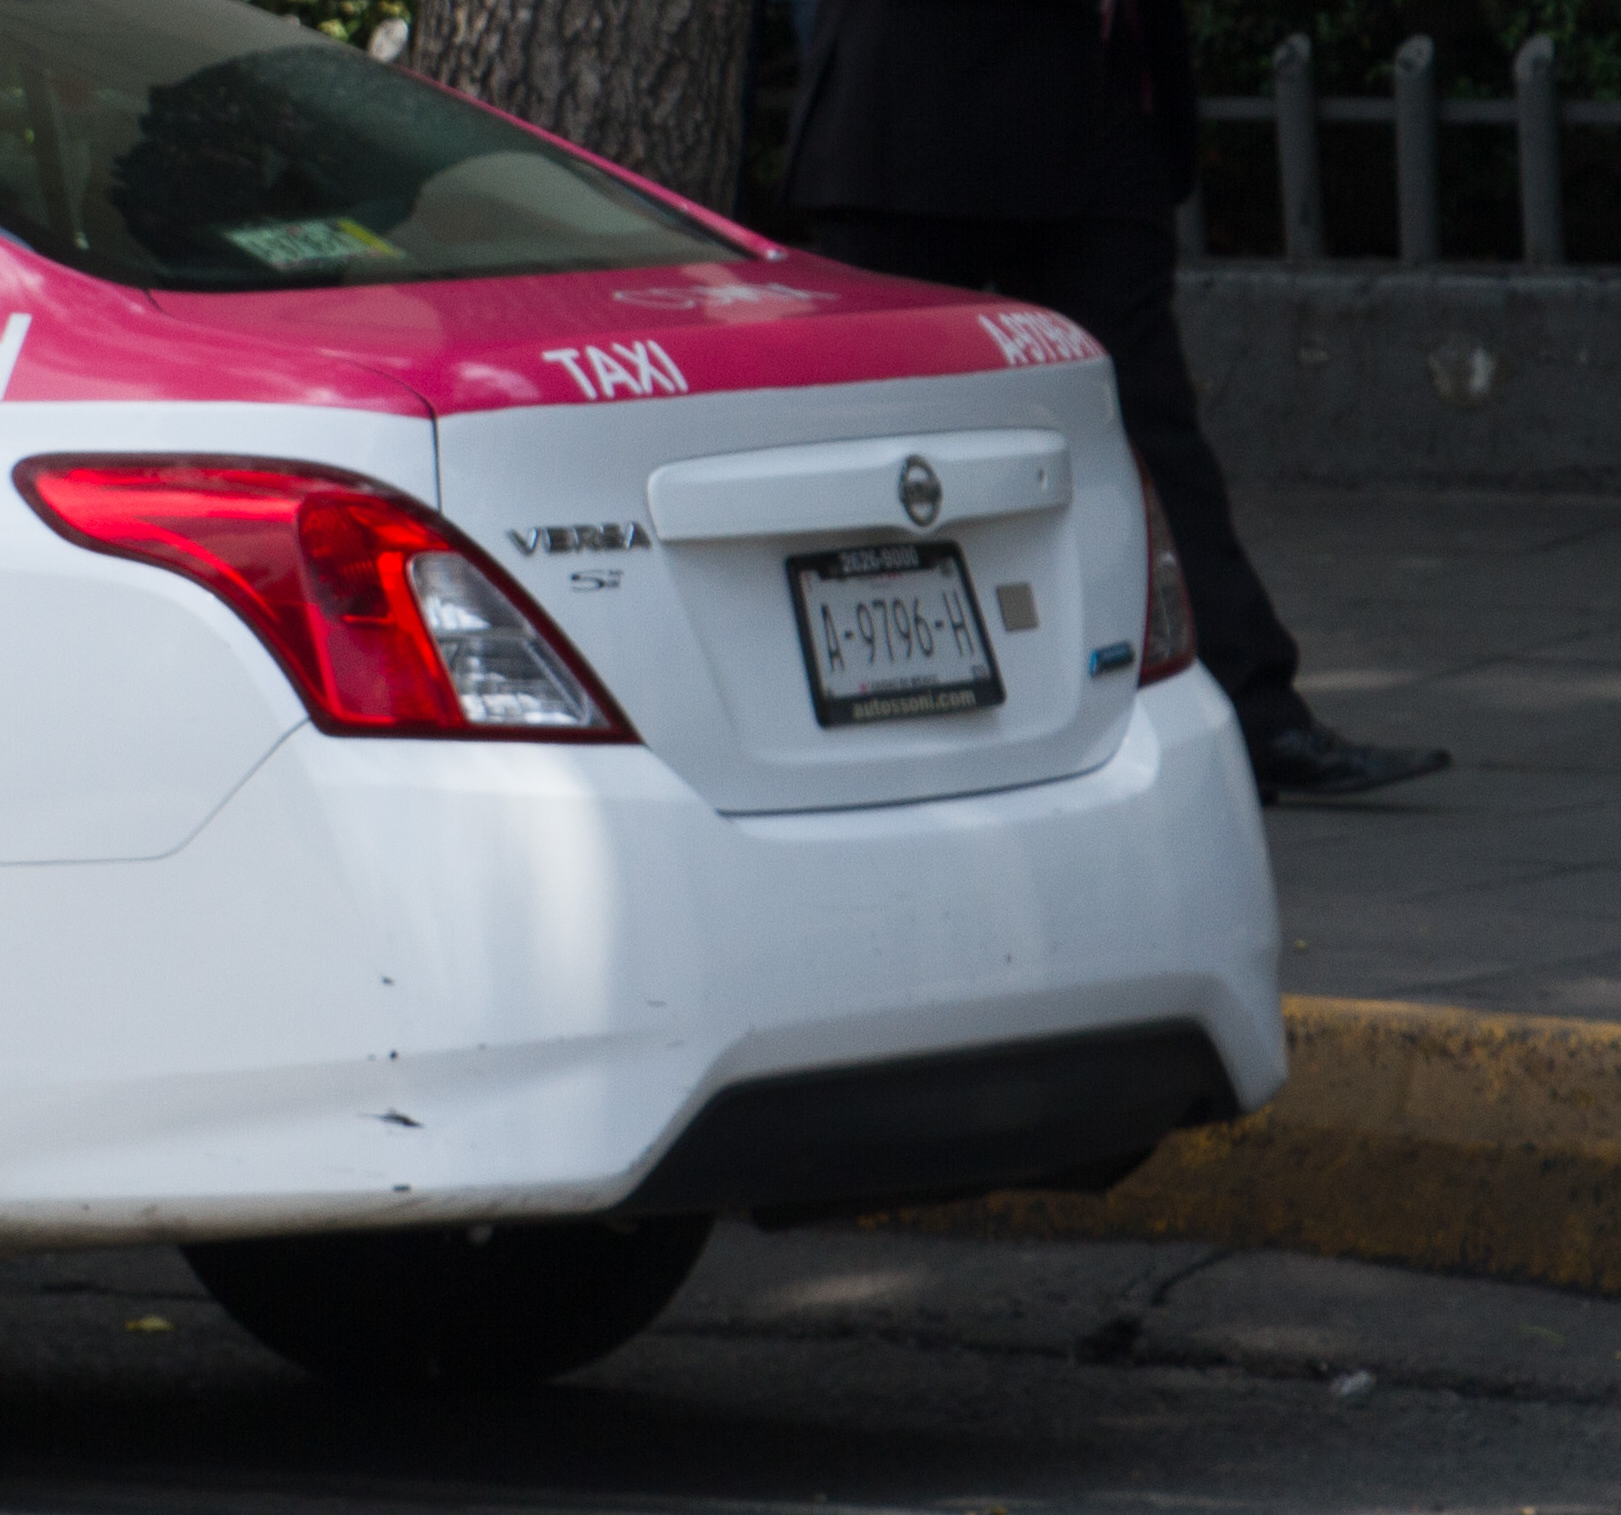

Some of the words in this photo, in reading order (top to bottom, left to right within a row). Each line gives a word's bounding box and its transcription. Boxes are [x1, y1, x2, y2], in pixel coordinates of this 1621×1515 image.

[541, 339, 689, 401] TAXI
[506, 520, 651, 558] VERSA
[820, 588, 975, 673] A-9796-H
